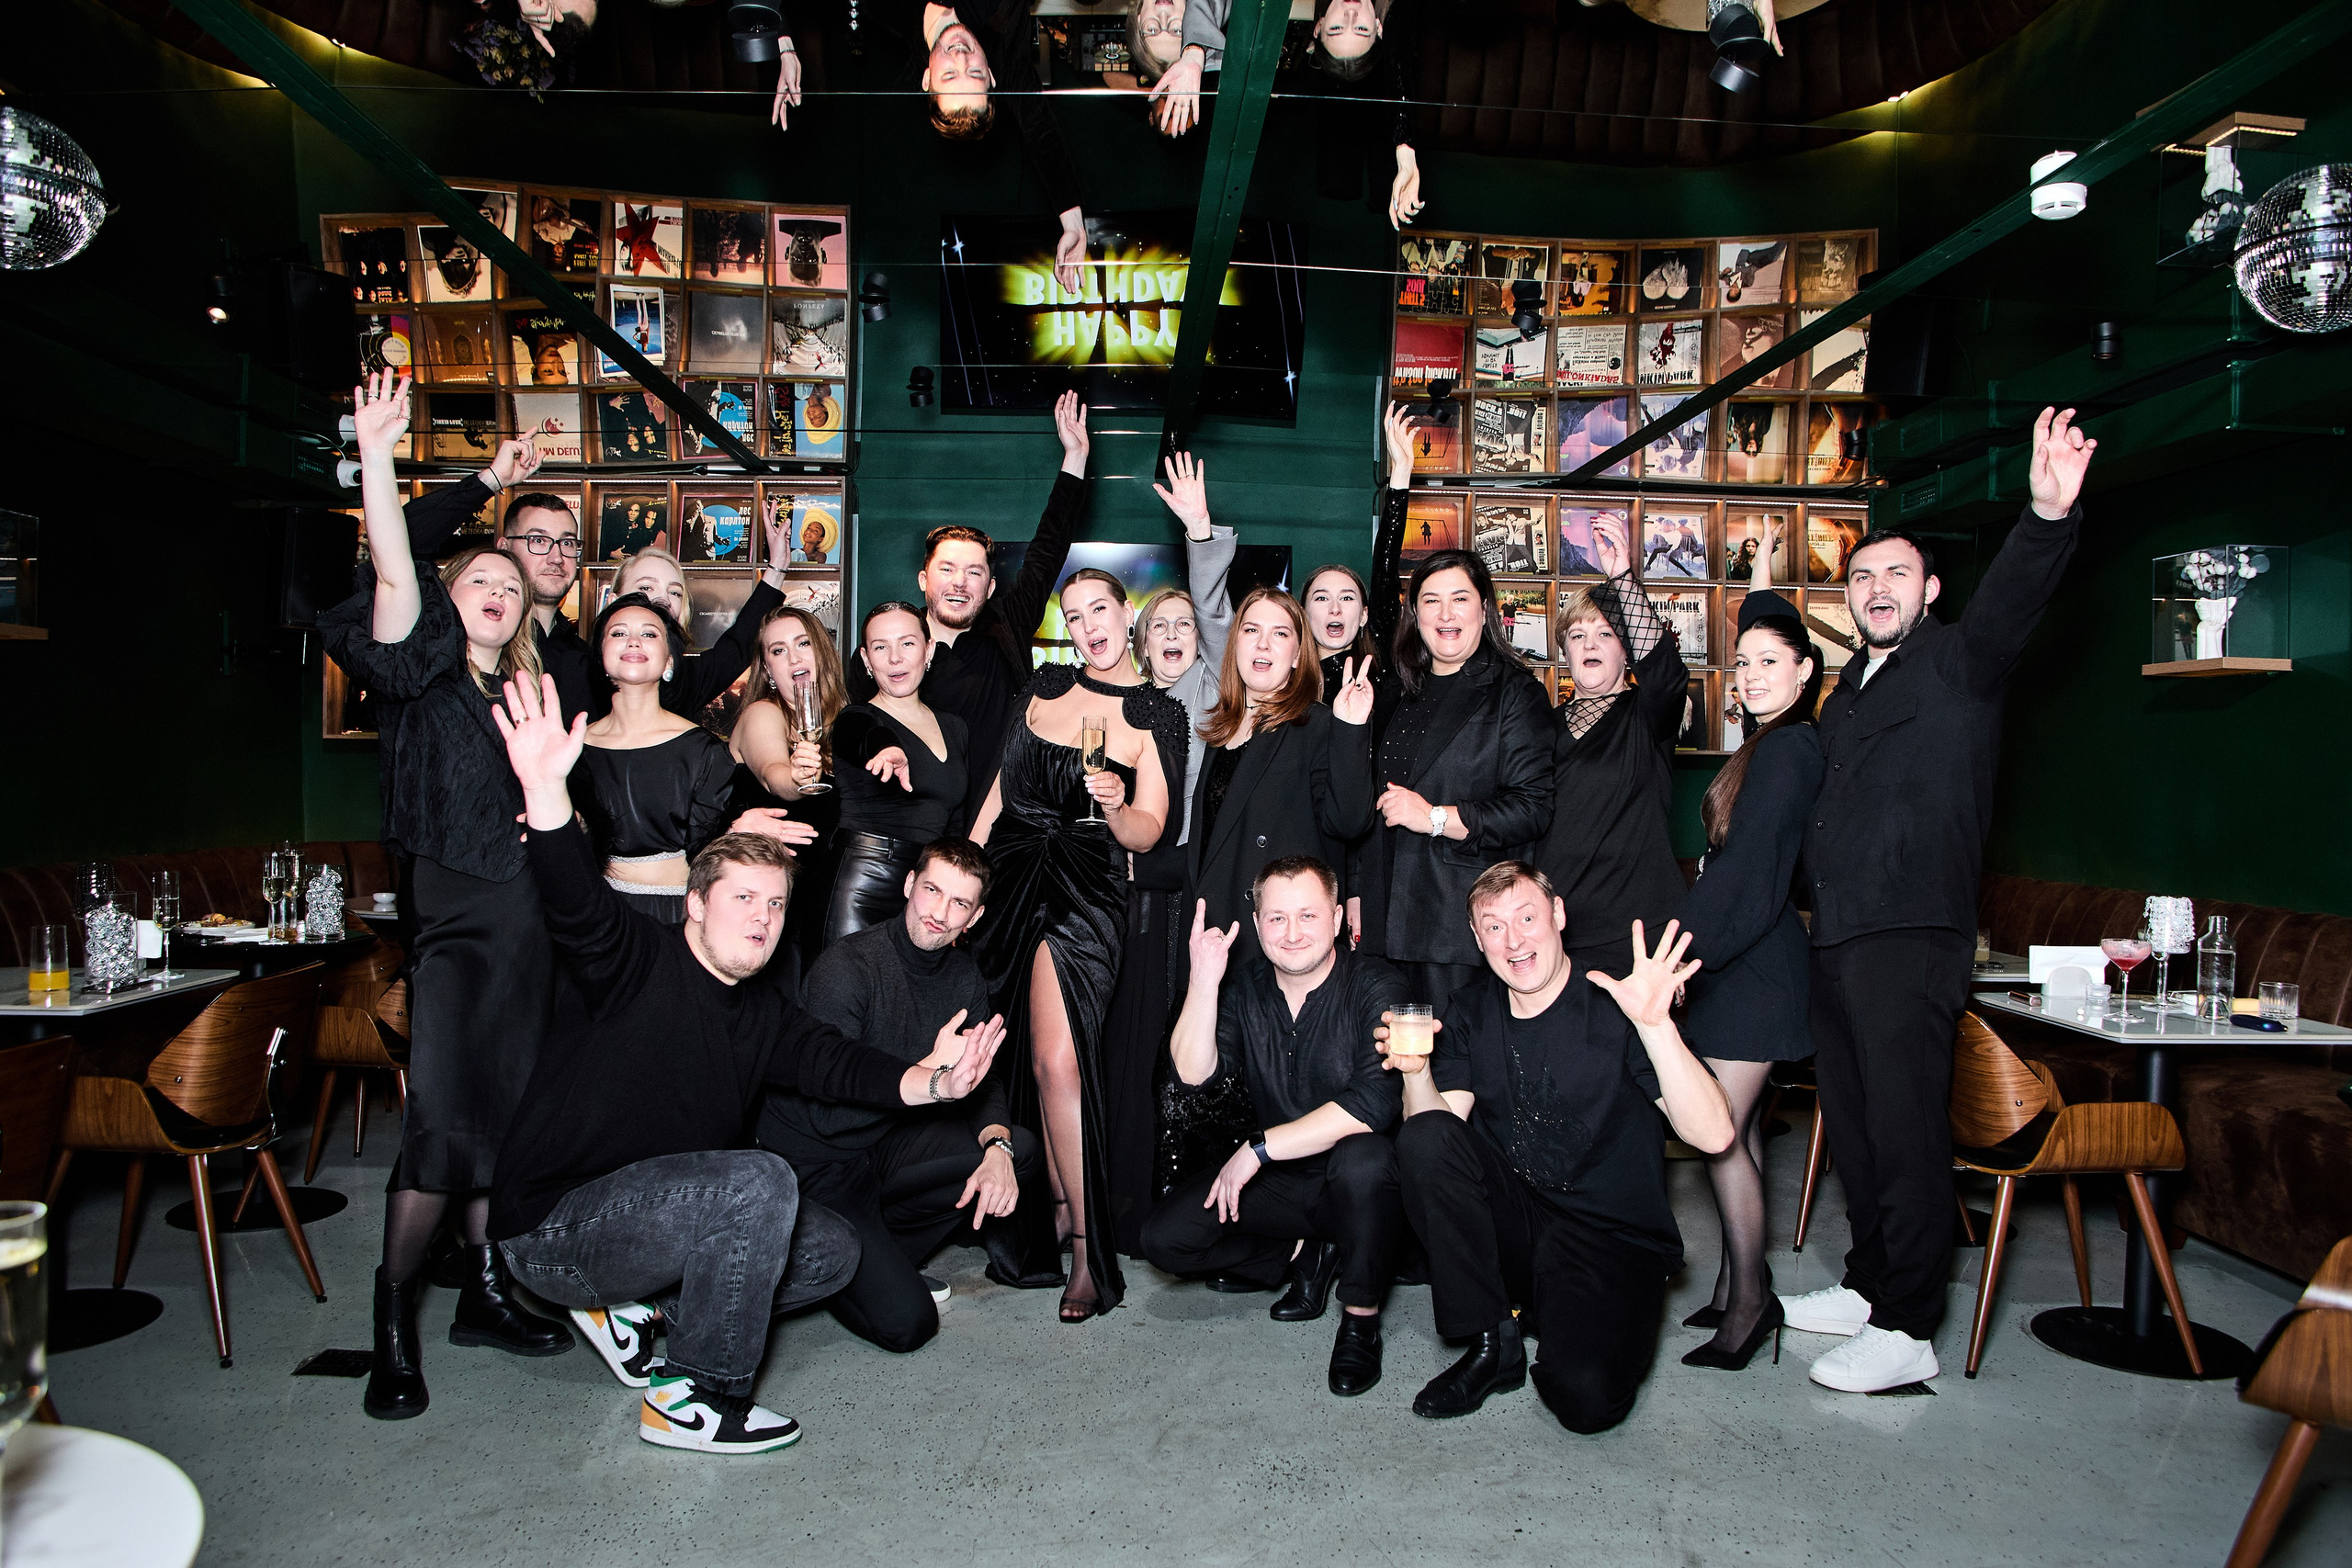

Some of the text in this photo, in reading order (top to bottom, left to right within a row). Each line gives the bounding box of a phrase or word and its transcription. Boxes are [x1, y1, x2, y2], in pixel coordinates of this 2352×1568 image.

[739, 506, 752, 515] лес
[719, 516, 751, 526] карлтон
[1673, 601, 1700, 613] PARK
